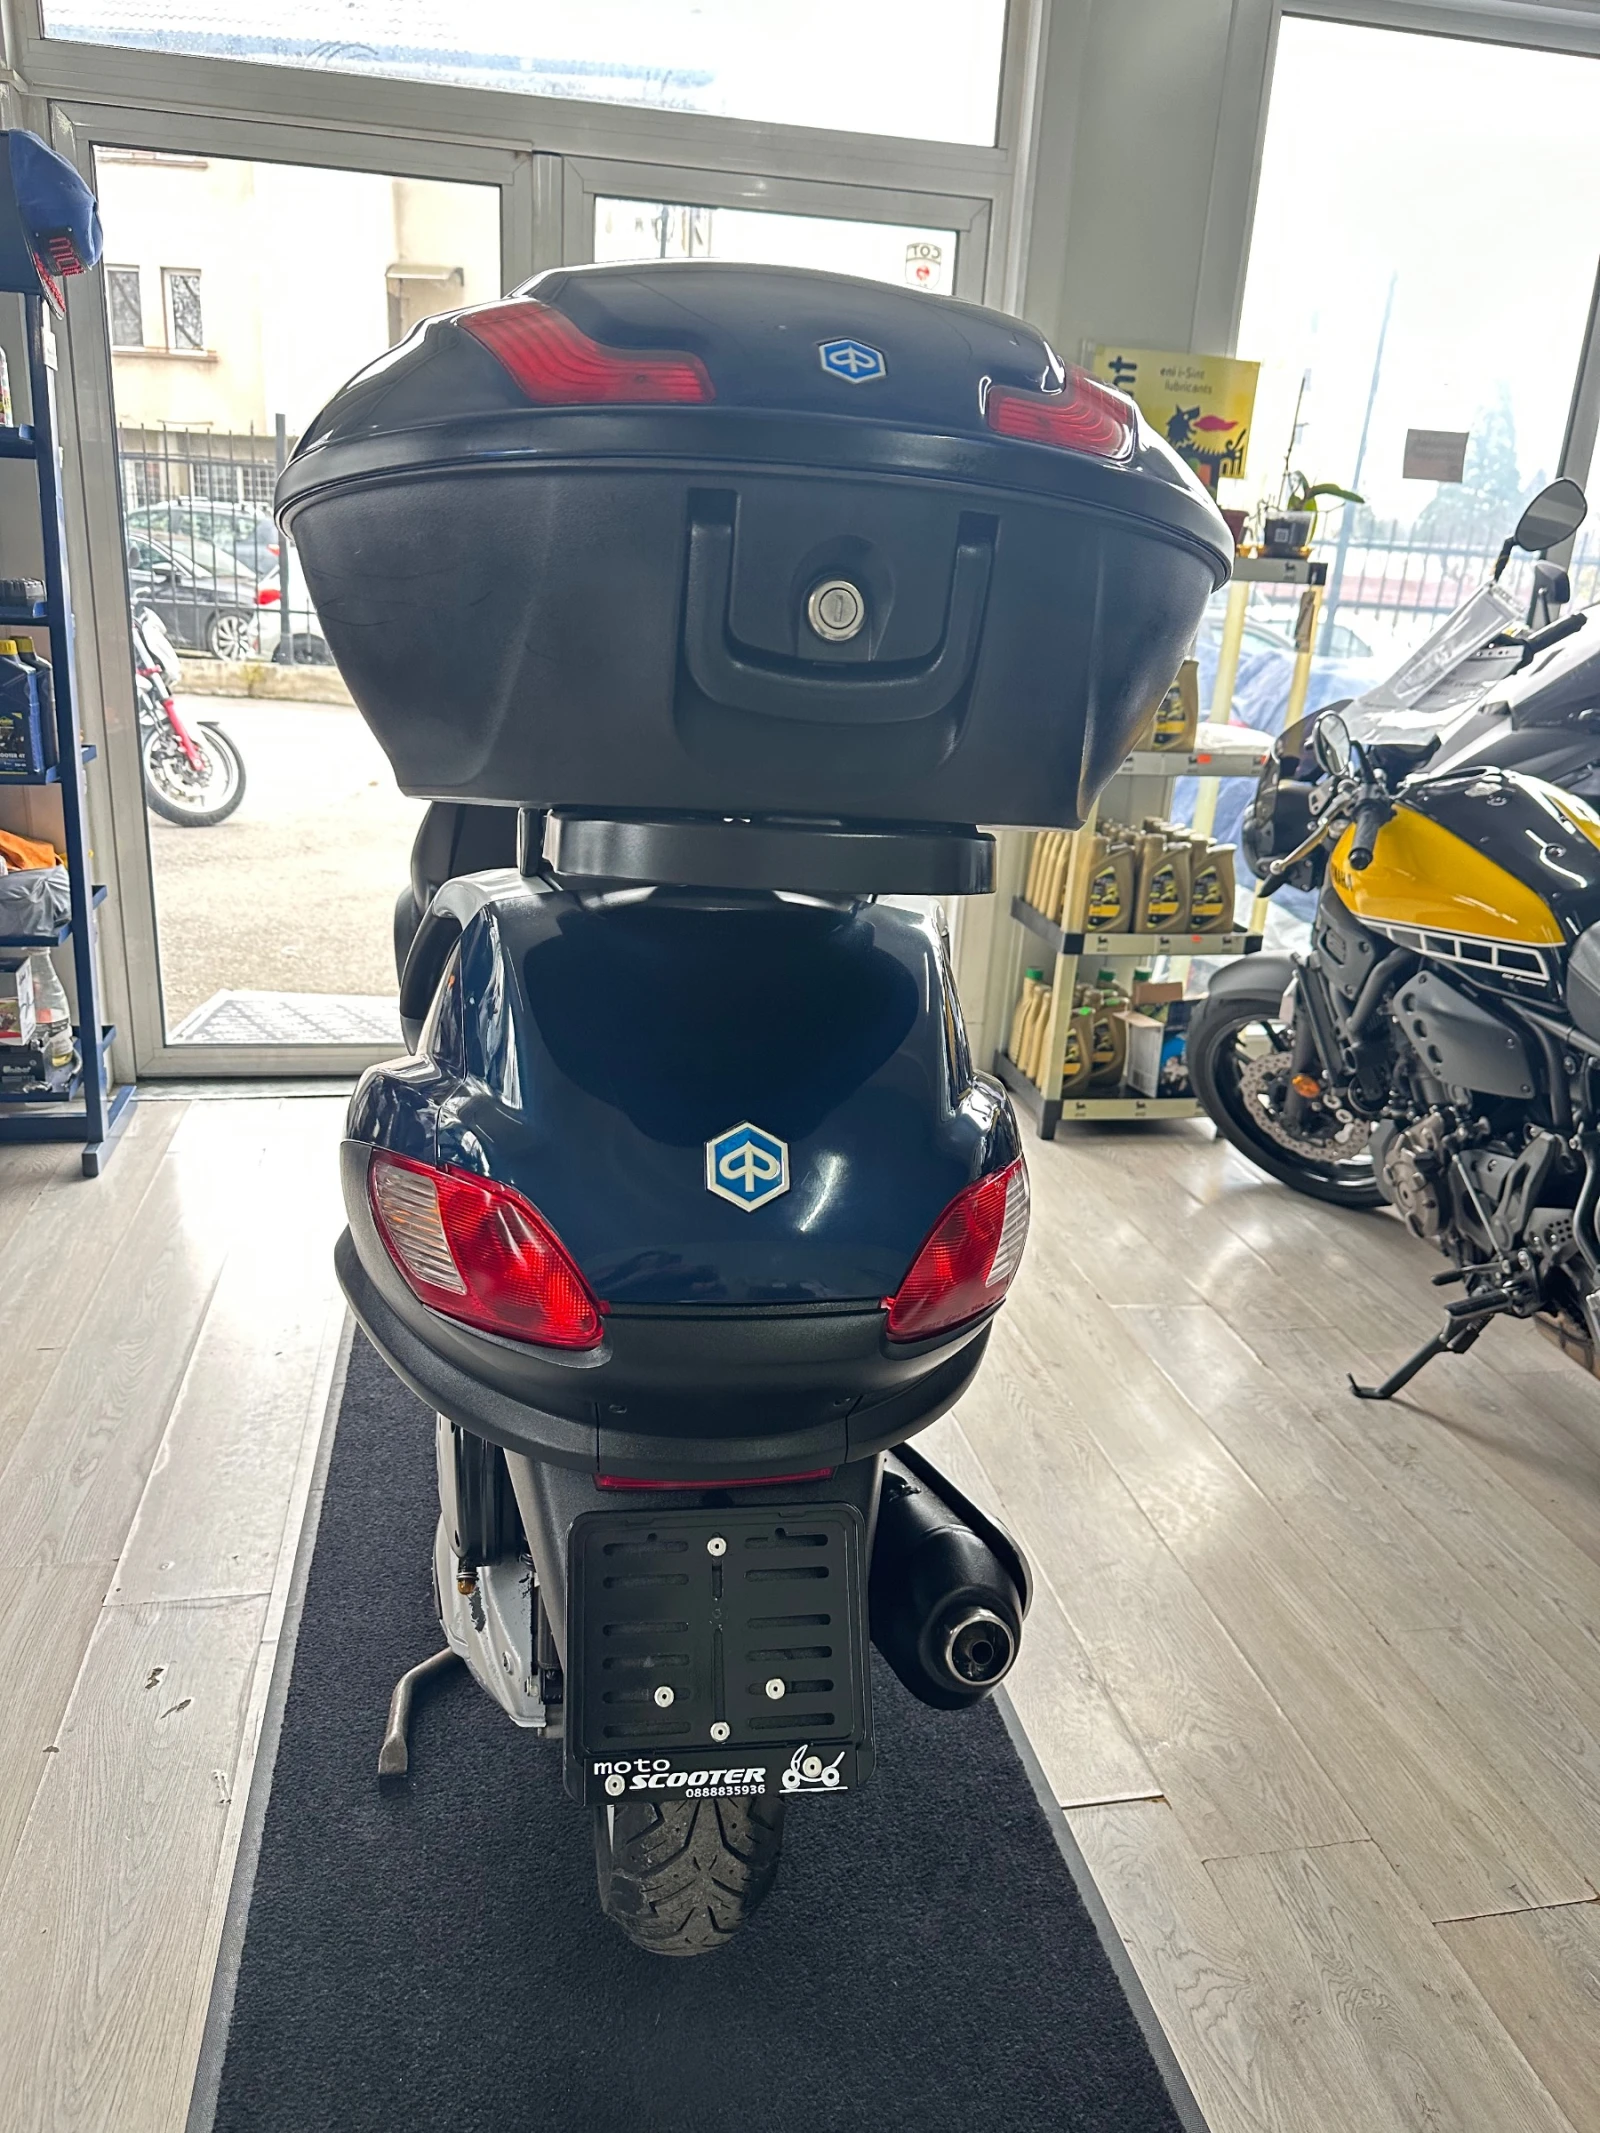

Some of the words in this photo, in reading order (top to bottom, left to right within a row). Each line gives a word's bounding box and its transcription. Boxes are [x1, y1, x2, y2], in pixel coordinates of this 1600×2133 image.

[1165, 379, 1213, 396] lubricants
[593, 1759, 671, 1775] moto
[629, 1767, 767, 1791] SCOOTER
[685, 1784, 766, 1798] 0888835936
